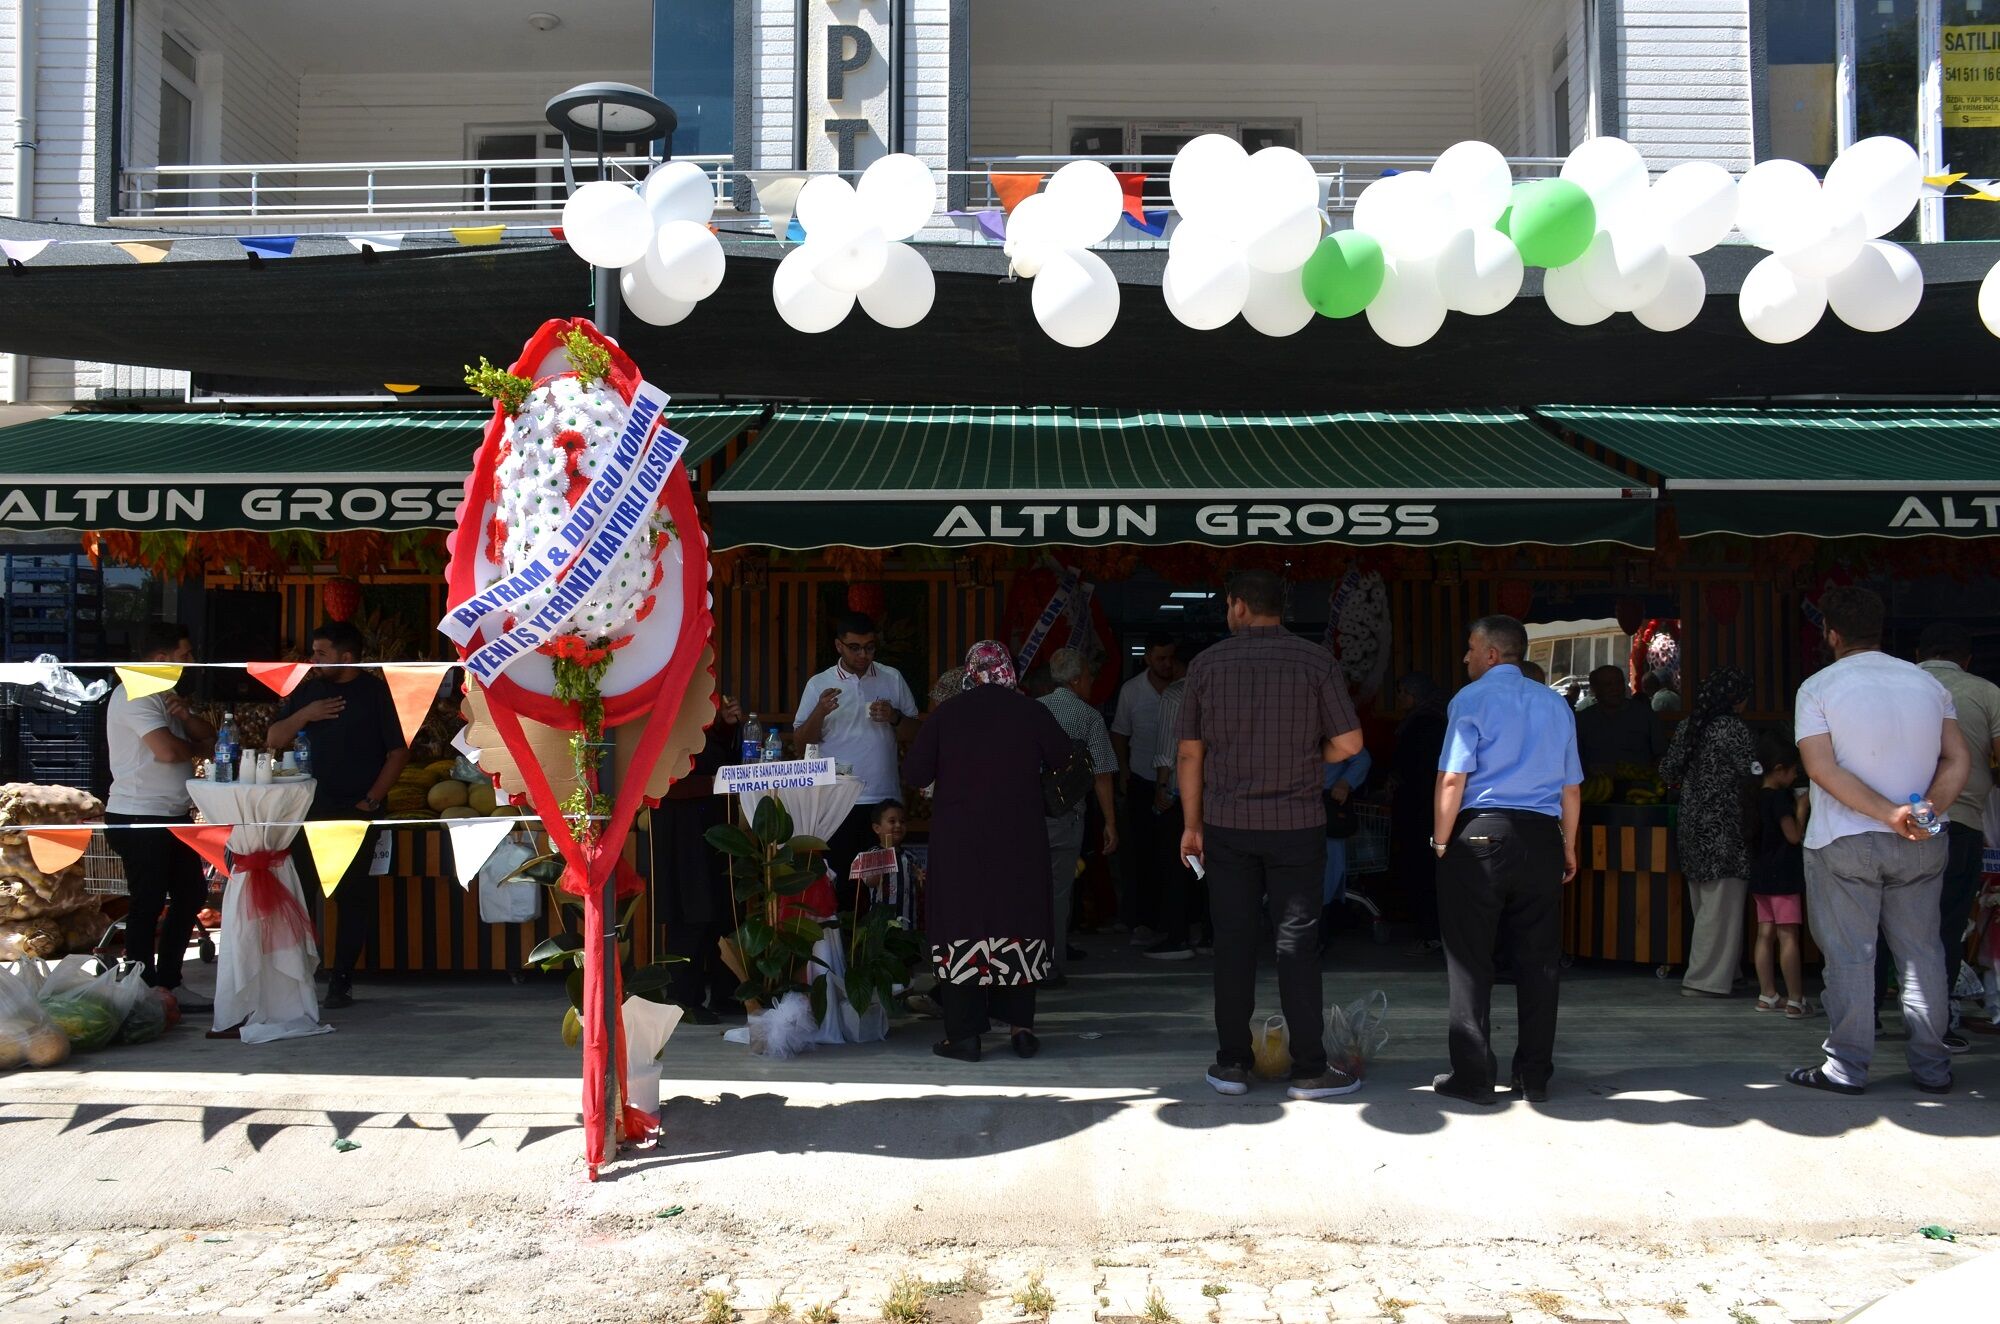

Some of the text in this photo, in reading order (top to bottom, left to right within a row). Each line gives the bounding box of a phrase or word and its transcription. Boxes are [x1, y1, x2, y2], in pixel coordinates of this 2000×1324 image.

[0, 488, 465, 521] ALTUN GROSS
[452, 394, 659, 628] BAYRAM & DUYGU KONAN
[589, 485, 649, 566] HAYIRLI
[637, 430, 682, 493] OLSUN
[1888, 496, 2000, 528] ALT
[933, 503, 1440, 537] ALTUN GROSS
[729, 780, 769, 792] EMRAH
